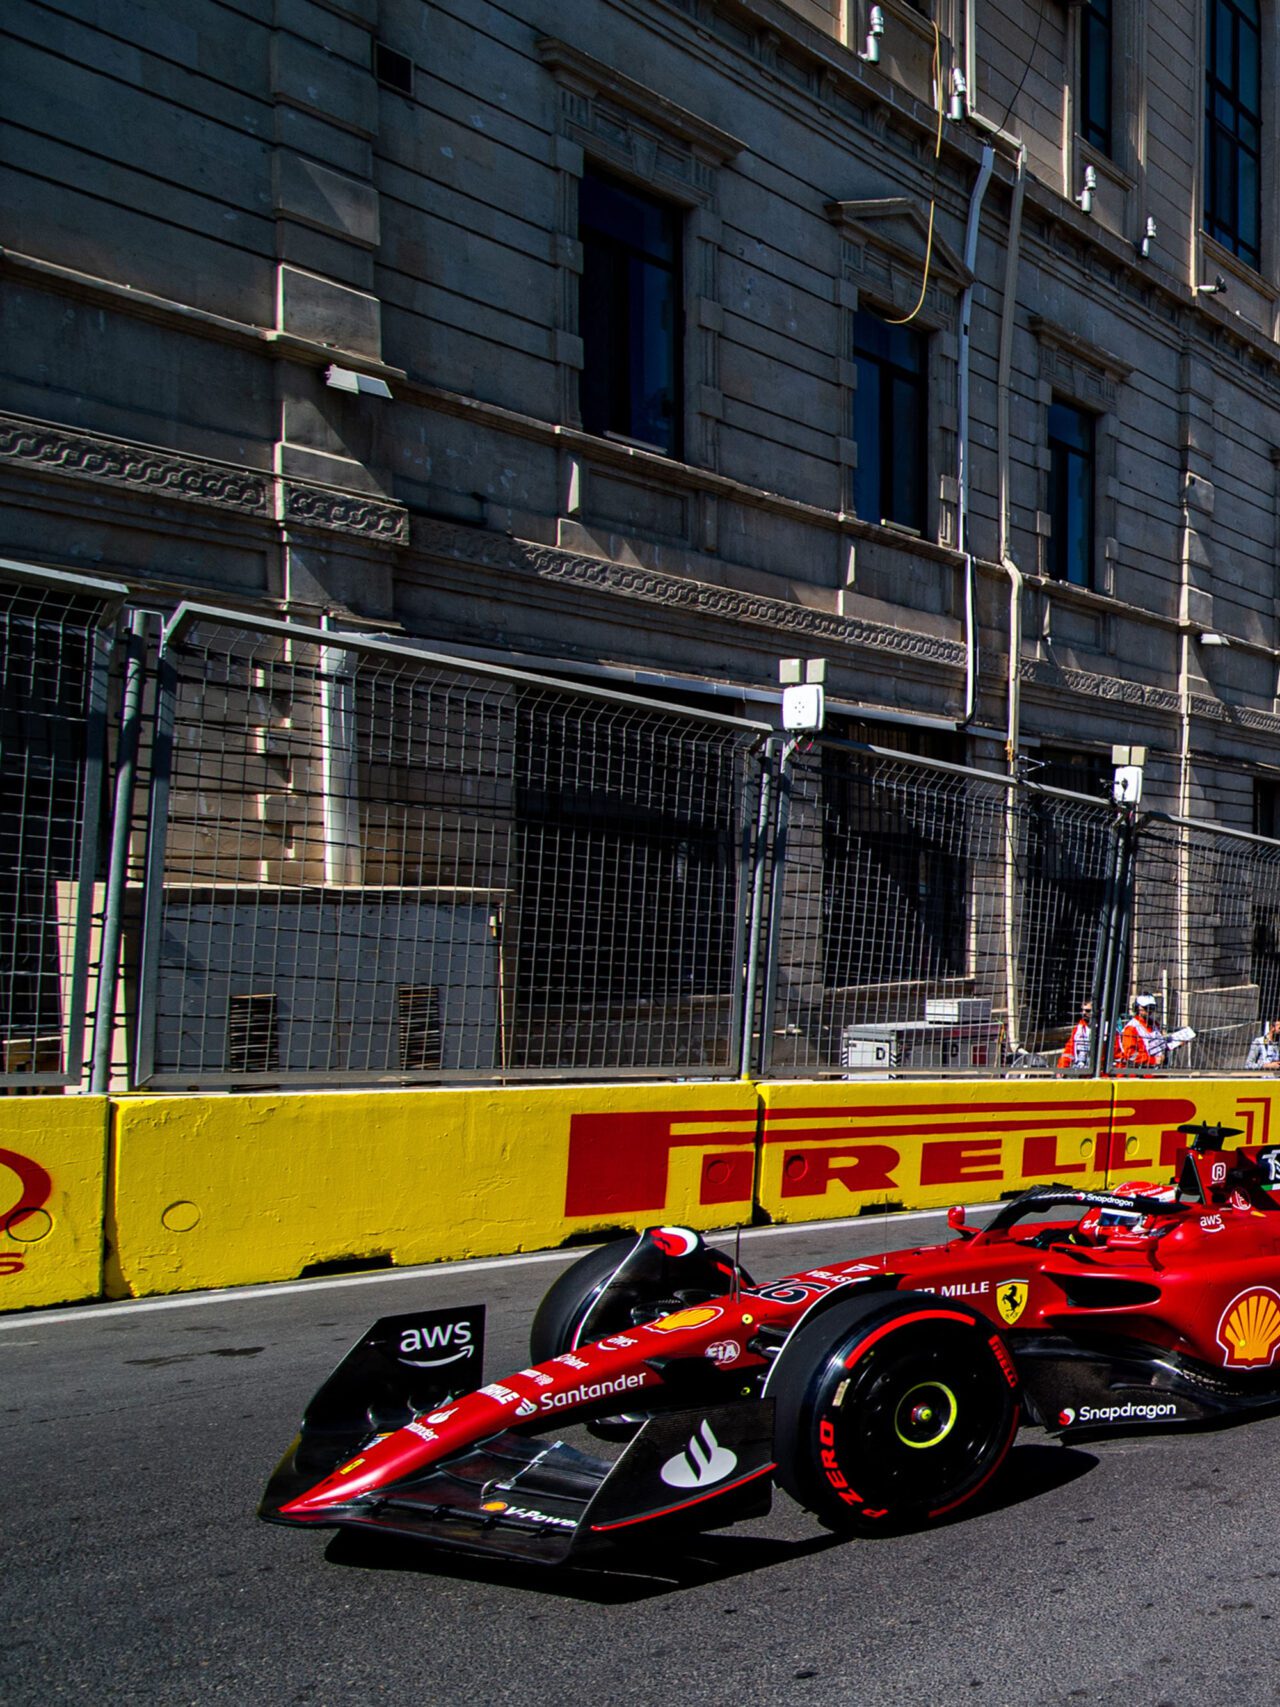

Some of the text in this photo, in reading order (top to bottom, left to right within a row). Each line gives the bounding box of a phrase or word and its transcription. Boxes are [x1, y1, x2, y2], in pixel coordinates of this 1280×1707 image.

[564, 1099, 1197, 1217] PIRELLI
[1087, 1193, 1134, 1207] Snapdragon
[1200, 1214, 1223, 1227] aws
[739, 1278, 831, 1305] 16
[941, 1281, 990, 1297] MILLE
[400, 1321, 472, 1352] aws
[706, 1343, 737, 1362] FIA
[540, 1372, 647, 1410] Santander
[1079, 1402, 1177, 1423] Snapdragon
[819, 1420, 888, 1519] P ZERO
[503, 1506, 578, 1527] V-Powe
